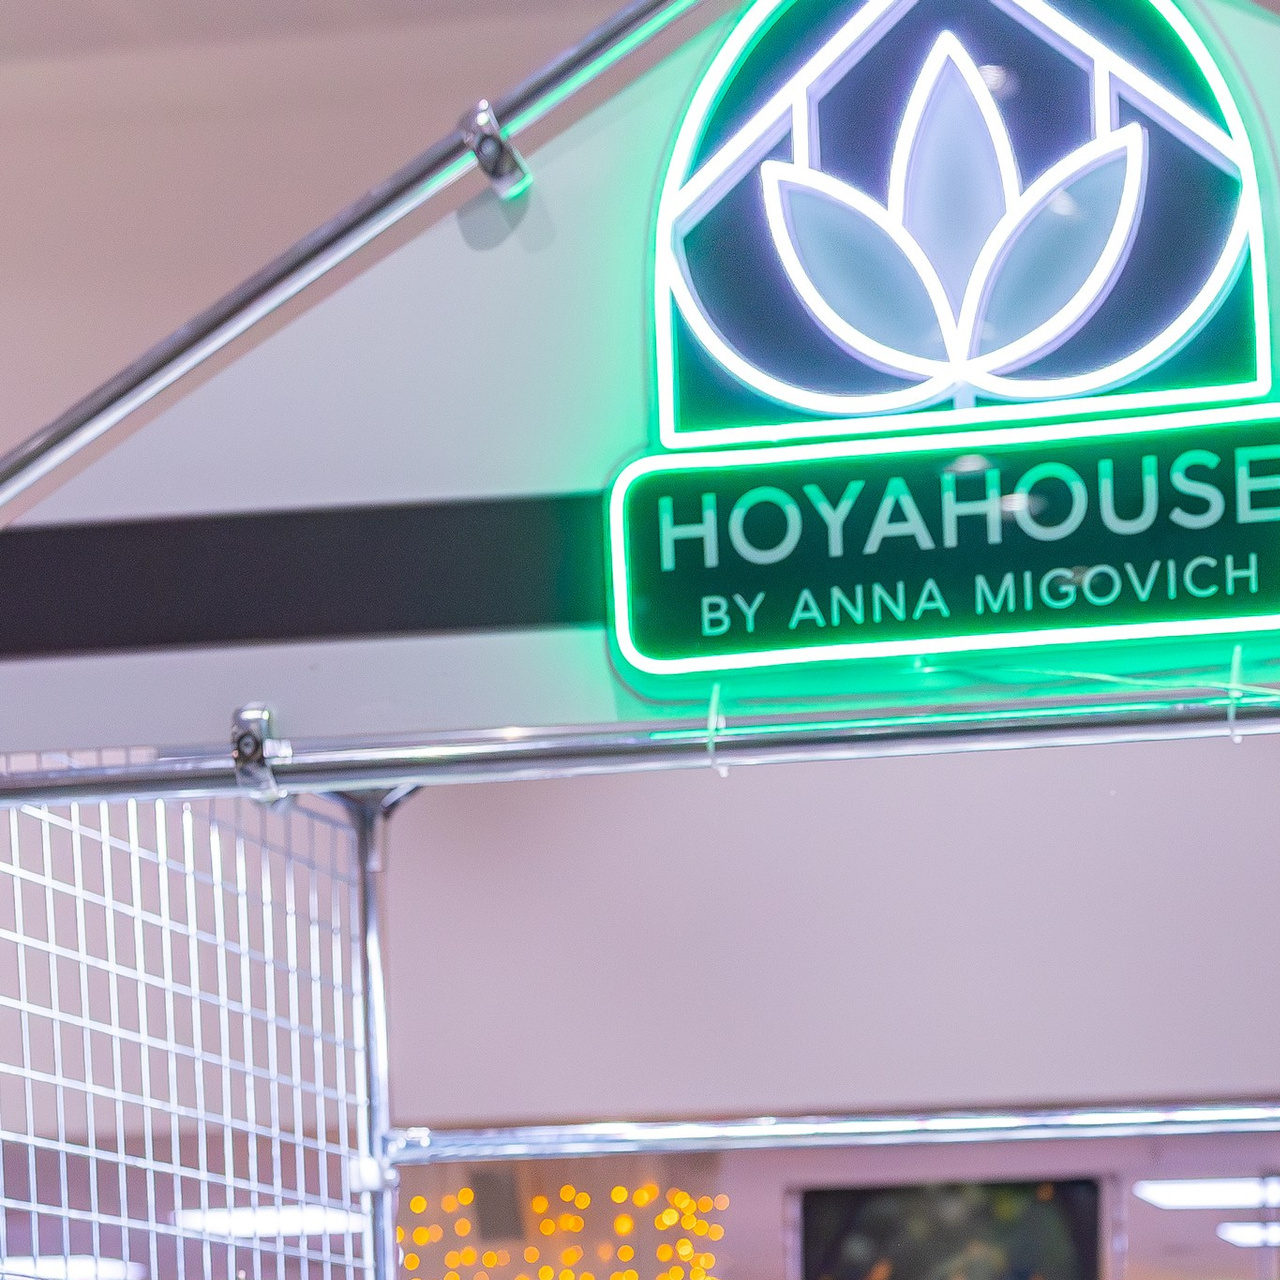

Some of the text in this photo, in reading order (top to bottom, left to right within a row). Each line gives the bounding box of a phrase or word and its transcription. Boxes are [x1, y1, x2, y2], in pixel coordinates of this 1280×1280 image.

[701, 552, 1259, 637] BY ANNA MIGOVICH
